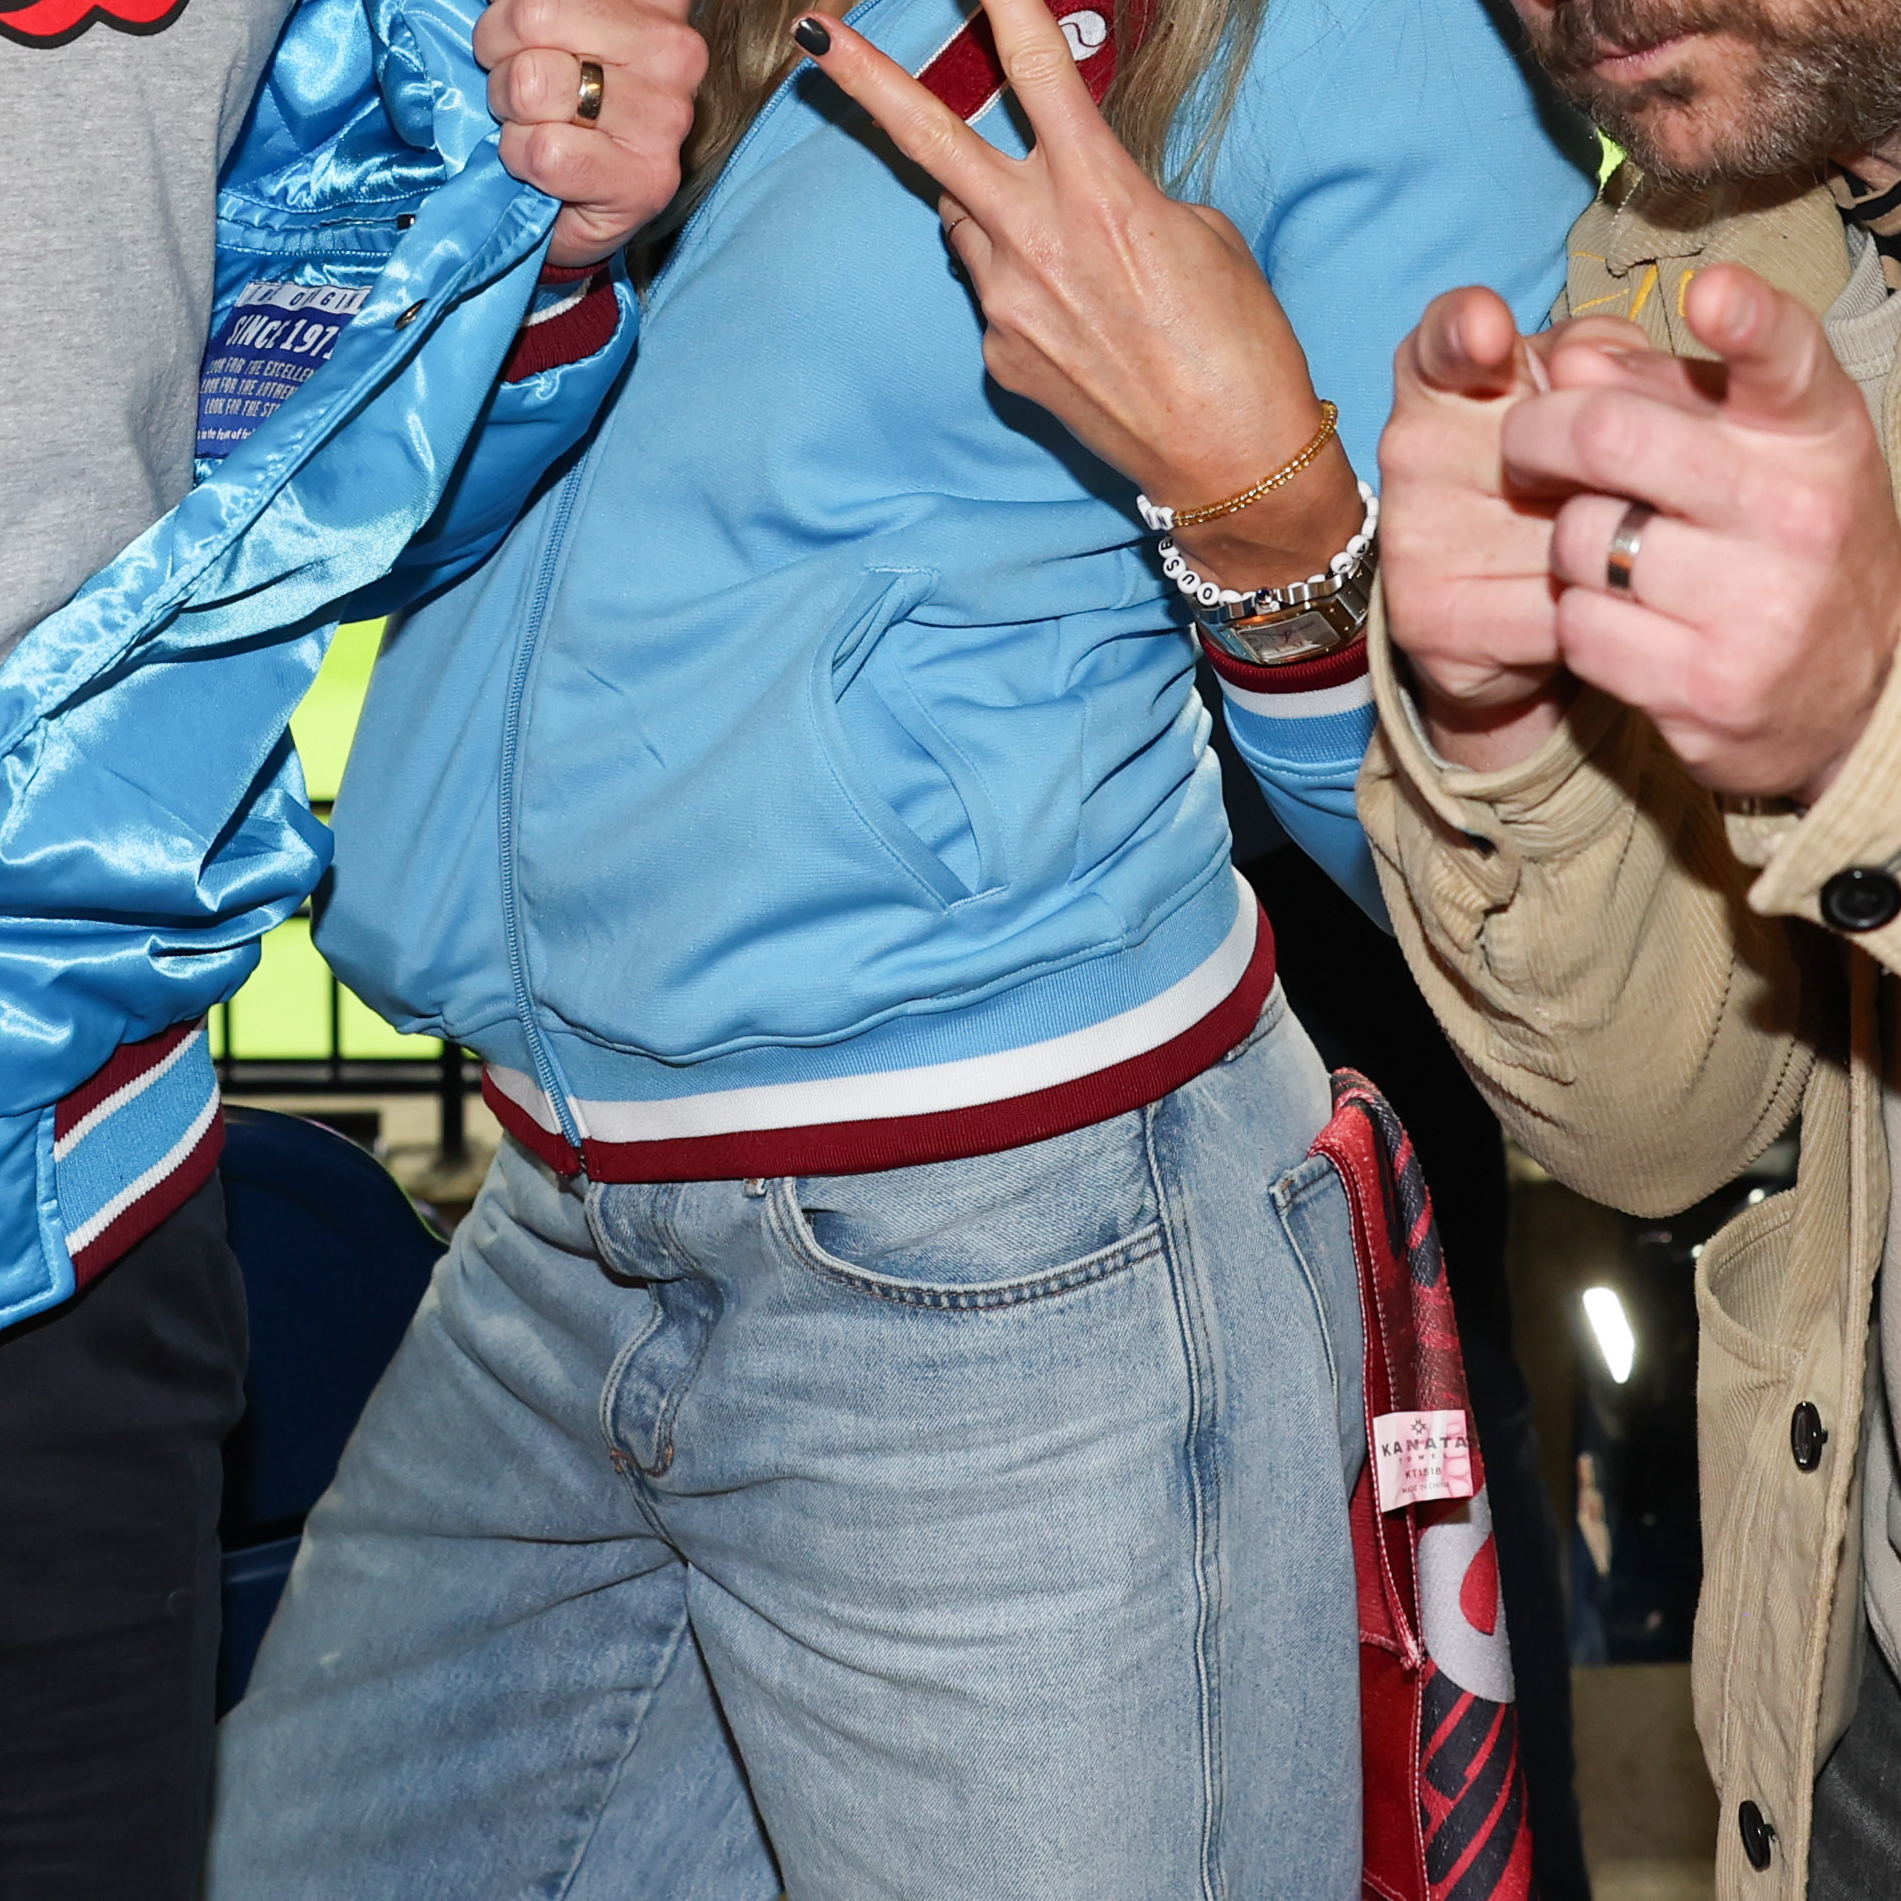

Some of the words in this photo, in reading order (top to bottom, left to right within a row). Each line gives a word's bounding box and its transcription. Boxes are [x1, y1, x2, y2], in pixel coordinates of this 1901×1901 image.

[226, 313, 292, 350] SINCE
[225, 356, 246, 374] FOR
[245, 360, 265, 375] THE
[200, 376, 221, 394] LOOK
[219, 376, 238, 394] FOR
[237, 378, 258, 396] THE
[204, 397, 226, 415] LOOK
[225, 397, 242, 416] FOR
[241, 399, 262, 417] THE
[1381, 1436, 1469, 1458] KANATA
[1401, 1485, 1418, 1494] MADE
[1419, 1483, 1428, 1491] IN
[1429, 1481, 1451, 1491] CHINA
